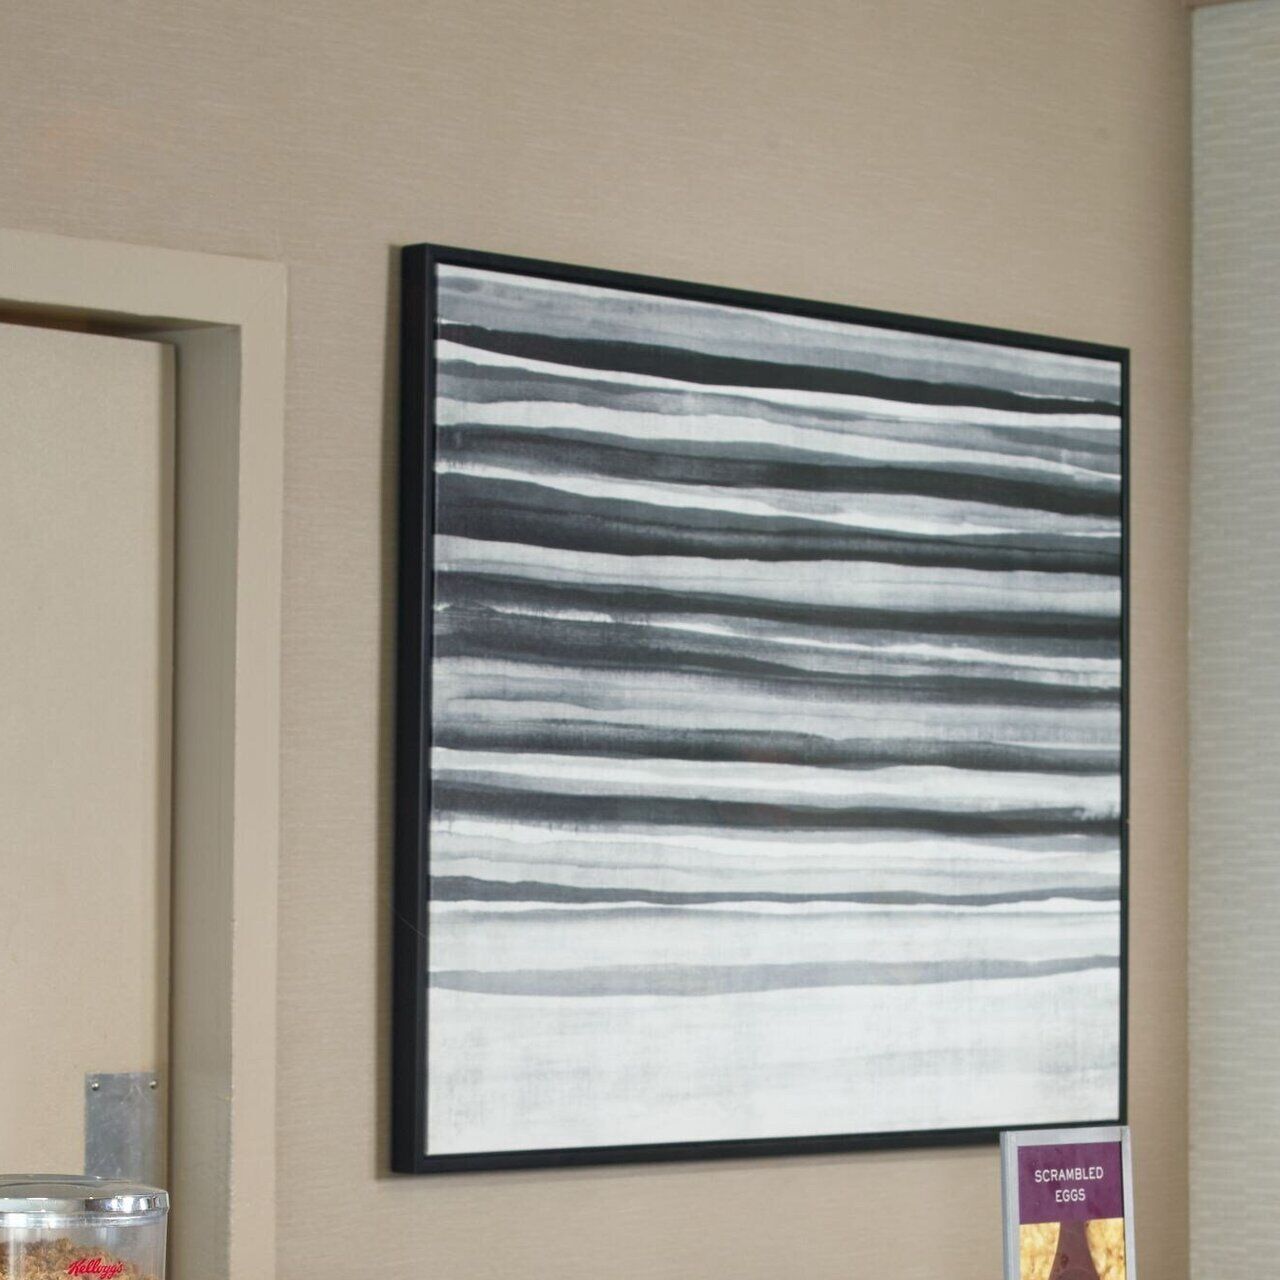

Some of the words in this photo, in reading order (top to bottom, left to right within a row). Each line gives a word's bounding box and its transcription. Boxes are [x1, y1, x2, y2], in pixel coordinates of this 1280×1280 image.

[1034, 1166, 1104, 1183] SCRAMBLED
[1055, 1188, 1086, 1202] EGGS
[67, 1258, 124, 1280] Kellogg's
